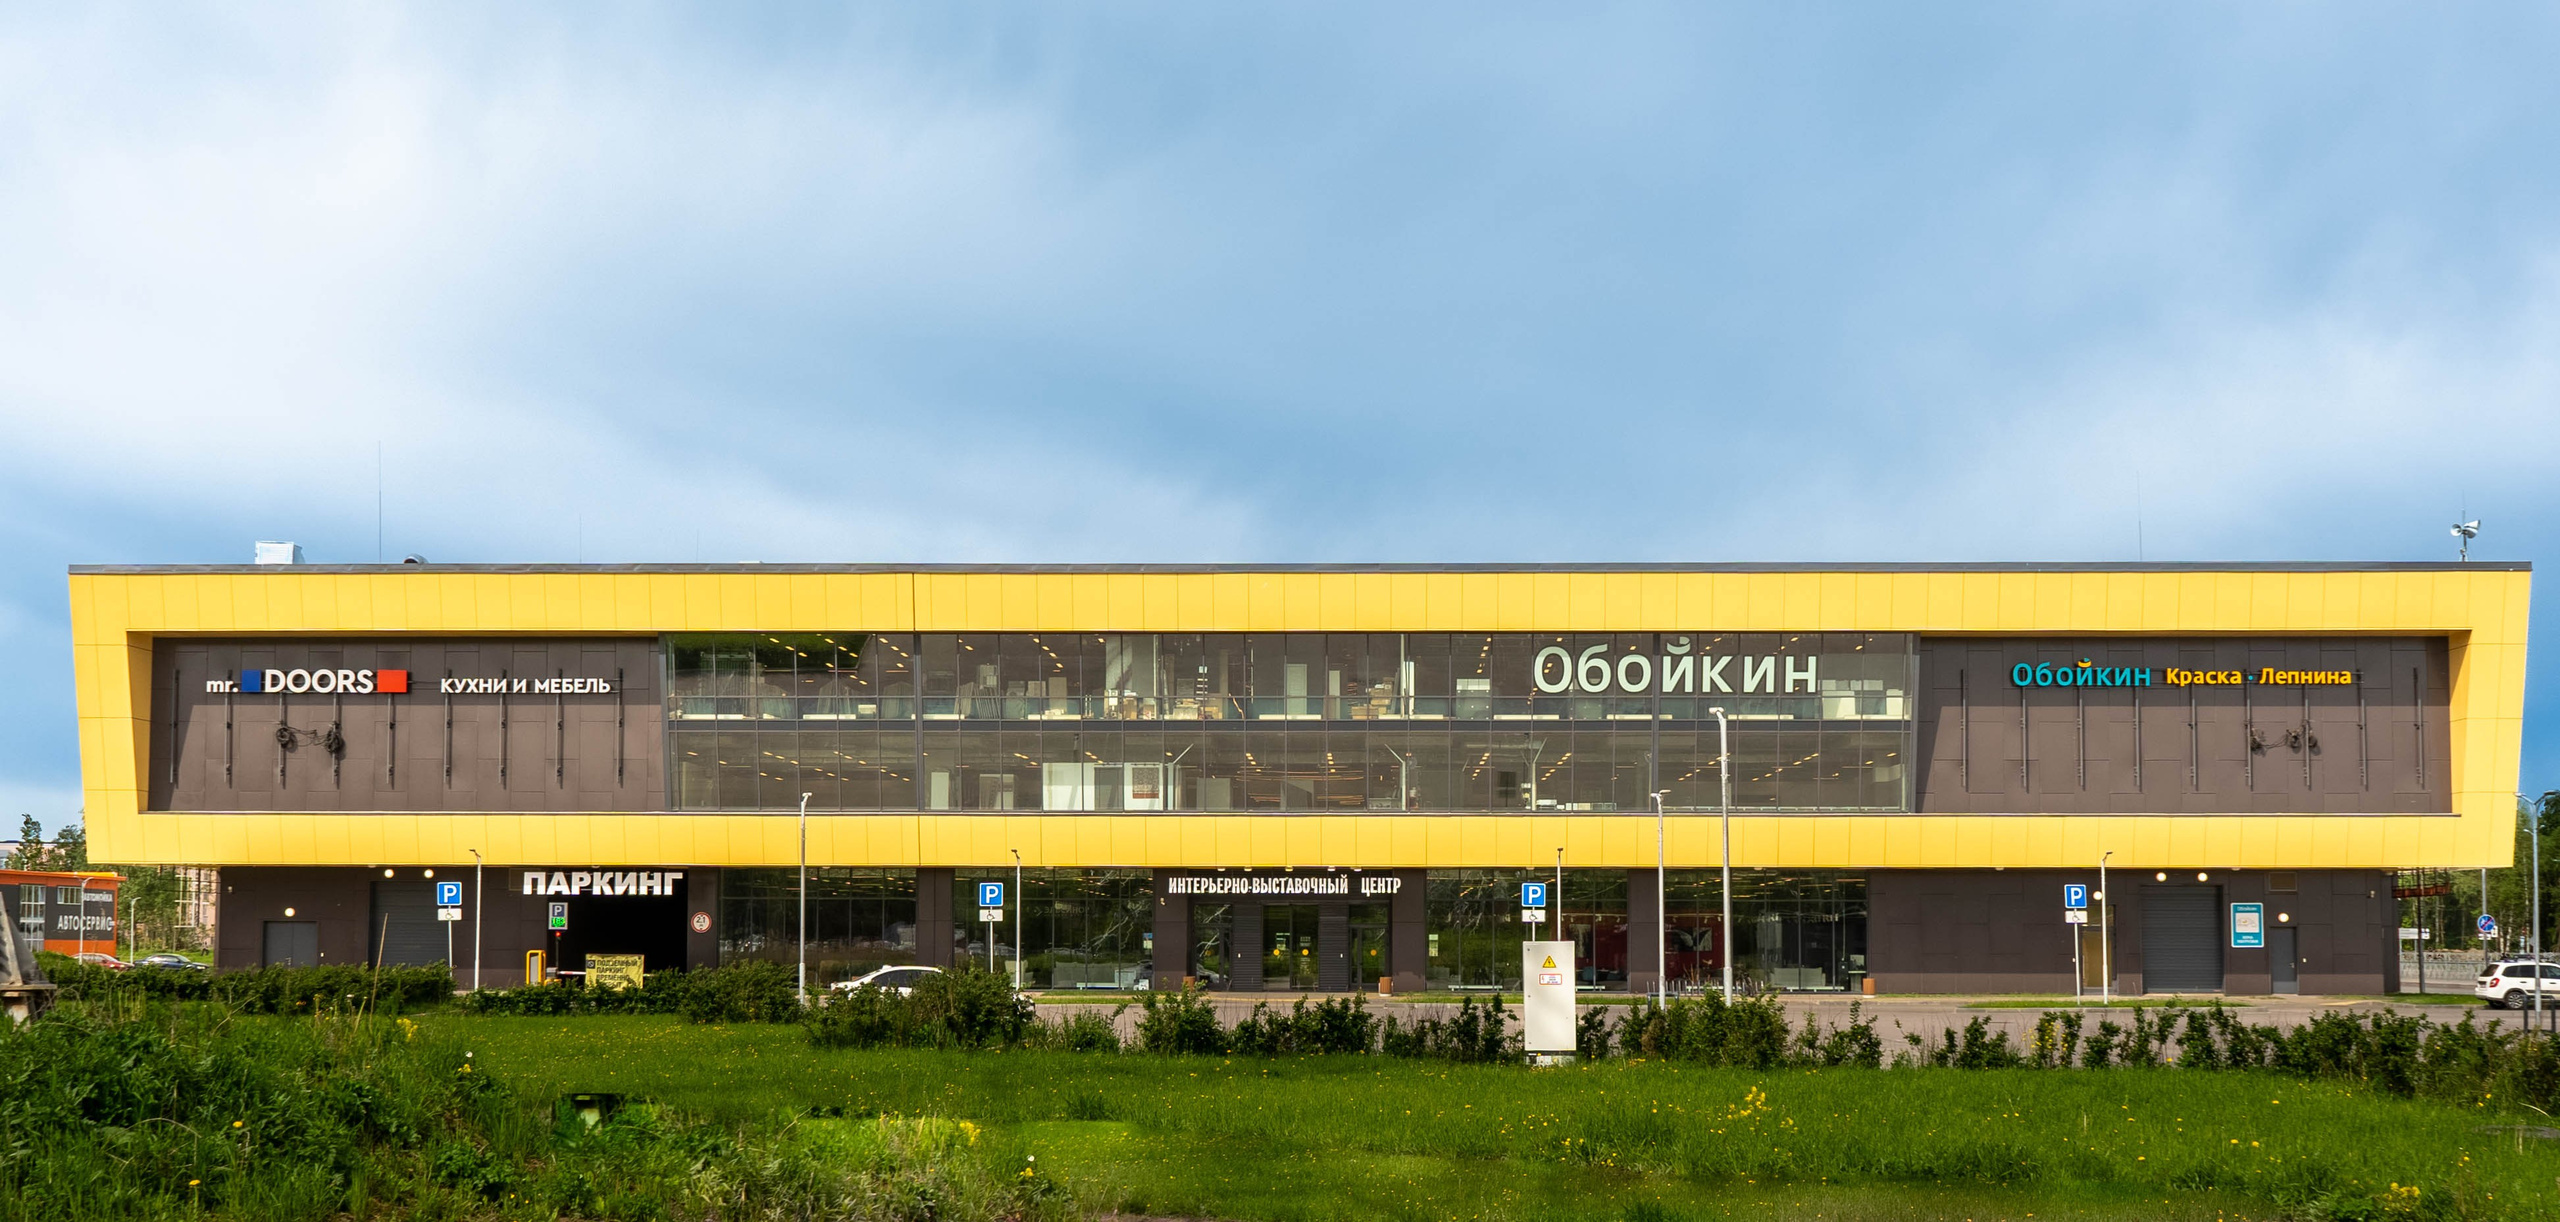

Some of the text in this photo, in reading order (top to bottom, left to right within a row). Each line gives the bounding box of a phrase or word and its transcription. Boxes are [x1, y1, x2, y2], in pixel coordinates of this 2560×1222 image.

[1533, 637, 1817, 694] Обойкин
[2013, 658, 2151, 687] Обойкин
[206, 669, 374, 693] mr. DOORS
[440, 678, 611, 693] КУХНИ И МЕБЕЛЬ
[2166, 668, 2352, 687] Краска Лепнина
[522, 871, 683, 896] ПАРКИНГ
[1168, 874, 1402, 897] ИНТЕРЬЕРНО-ВЫСТАВОЧНЫЙ ЦЕНТР
[443, 884, 458, 903] P
[985, 886, 999, 904] P
[1528, 886, 1542, 904] P
[2070, 887, 2083, 905] P
[57, 915, 114, 931] АВТОСЕРВИС
